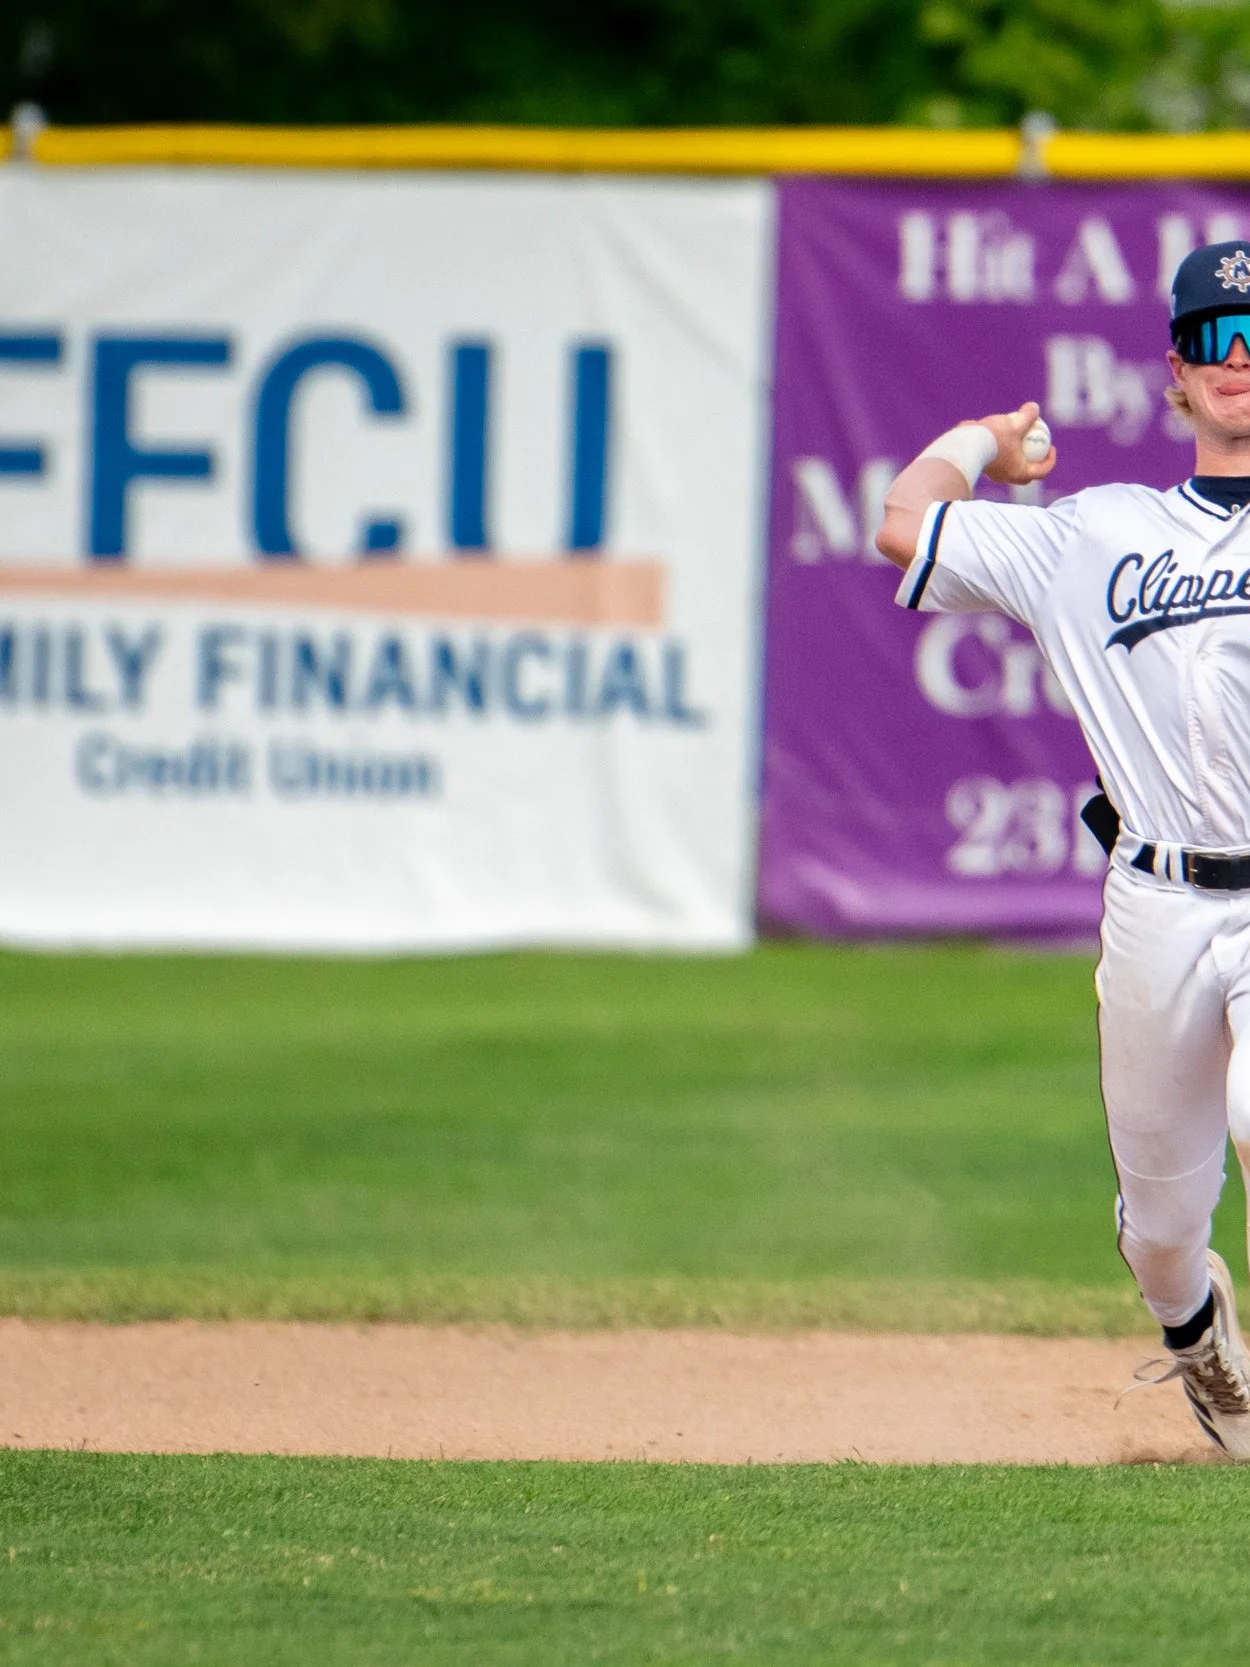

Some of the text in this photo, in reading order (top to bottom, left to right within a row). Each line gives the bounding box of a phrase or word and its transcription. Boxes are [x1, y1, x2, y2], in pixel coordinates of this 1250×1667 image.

[901, 212, 1035, 302] Hit
[1054, 217, 1139, 304] A
[1045, 334, 1163, 445] By
[0, 621, 708, 729] ILY FINANCIAL
[77, 733, 441, 798] Credit Union
